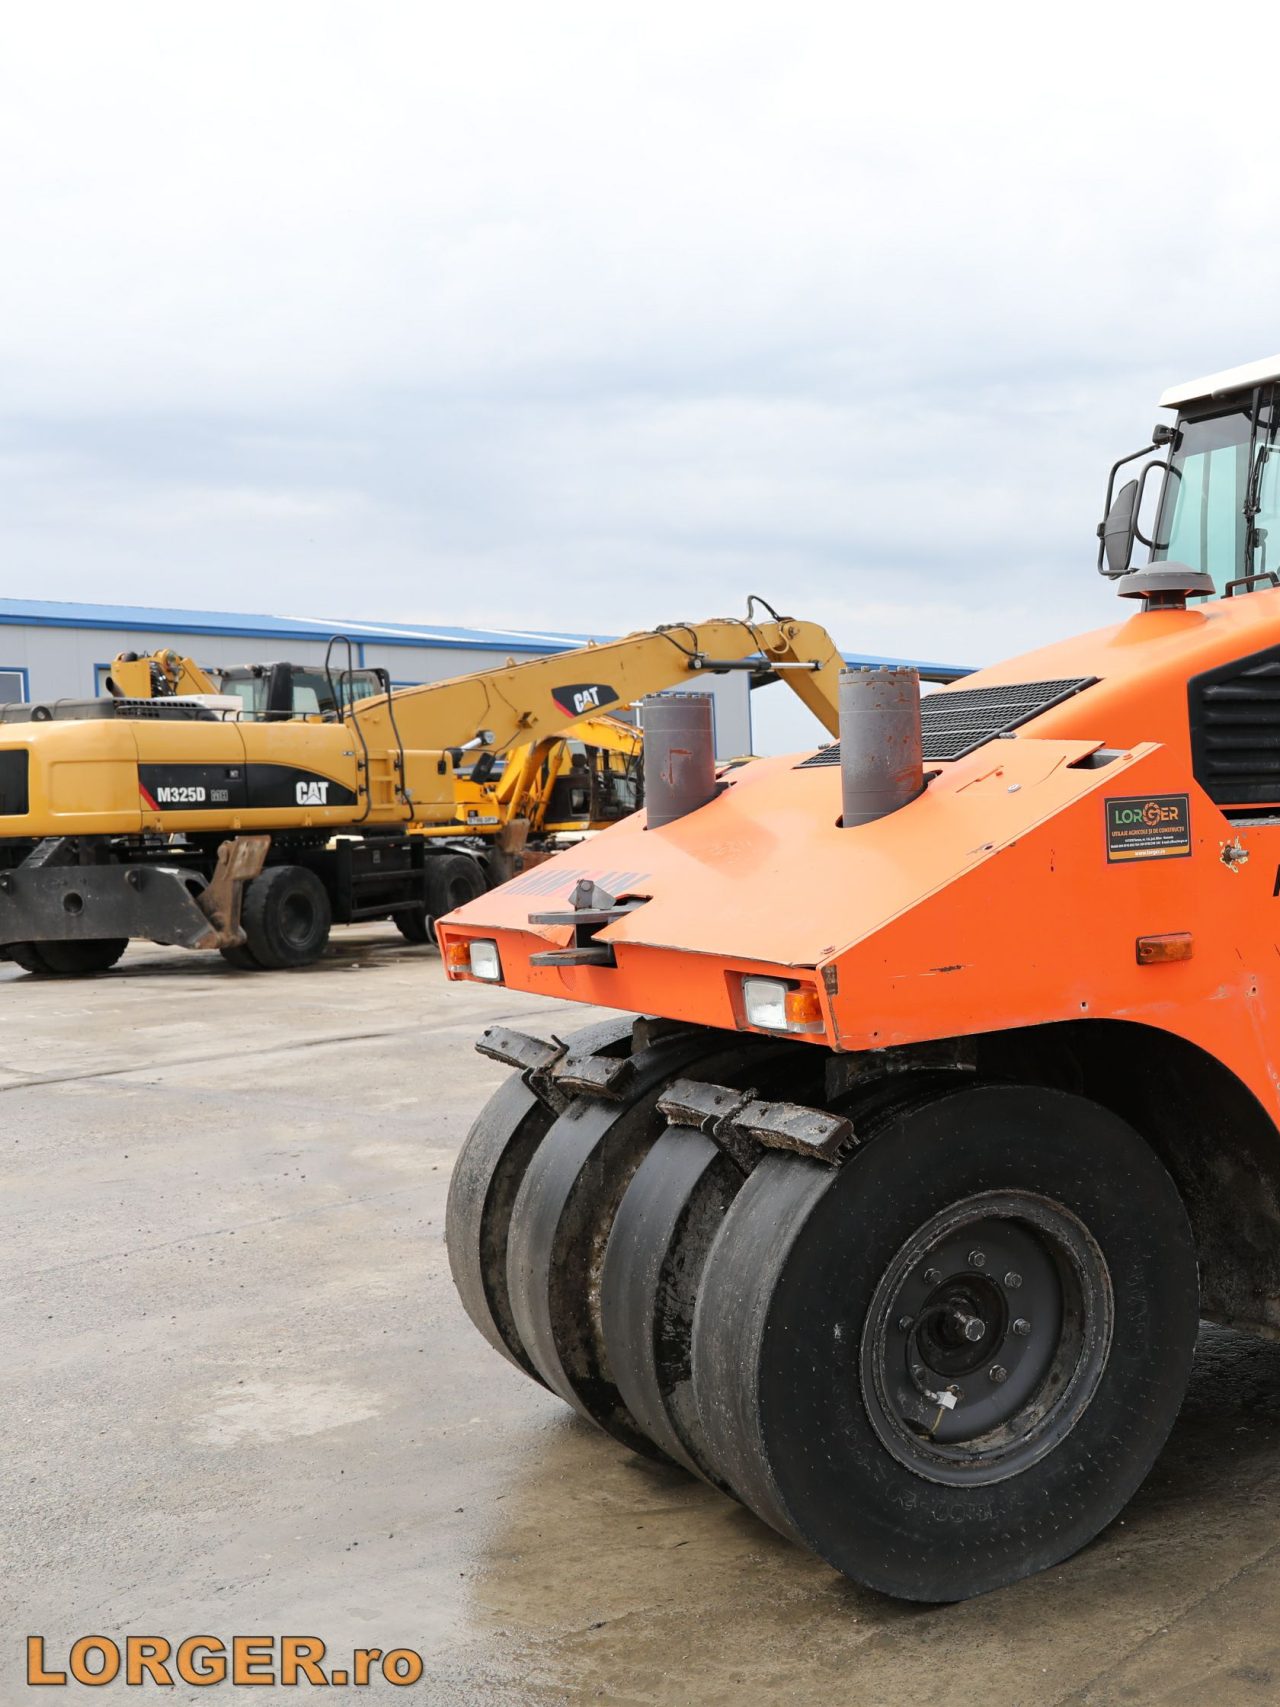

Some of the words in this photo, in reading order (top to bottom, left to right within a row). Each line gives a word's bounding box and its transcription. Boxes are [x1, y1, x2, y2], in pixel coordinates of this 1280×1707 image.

[573, 686, 600, 713] CAT
[157, 787, 206, 803] M325D
[296, 781, 330, 805] CAT
[1115, 802, 1179, 826] LORGER
